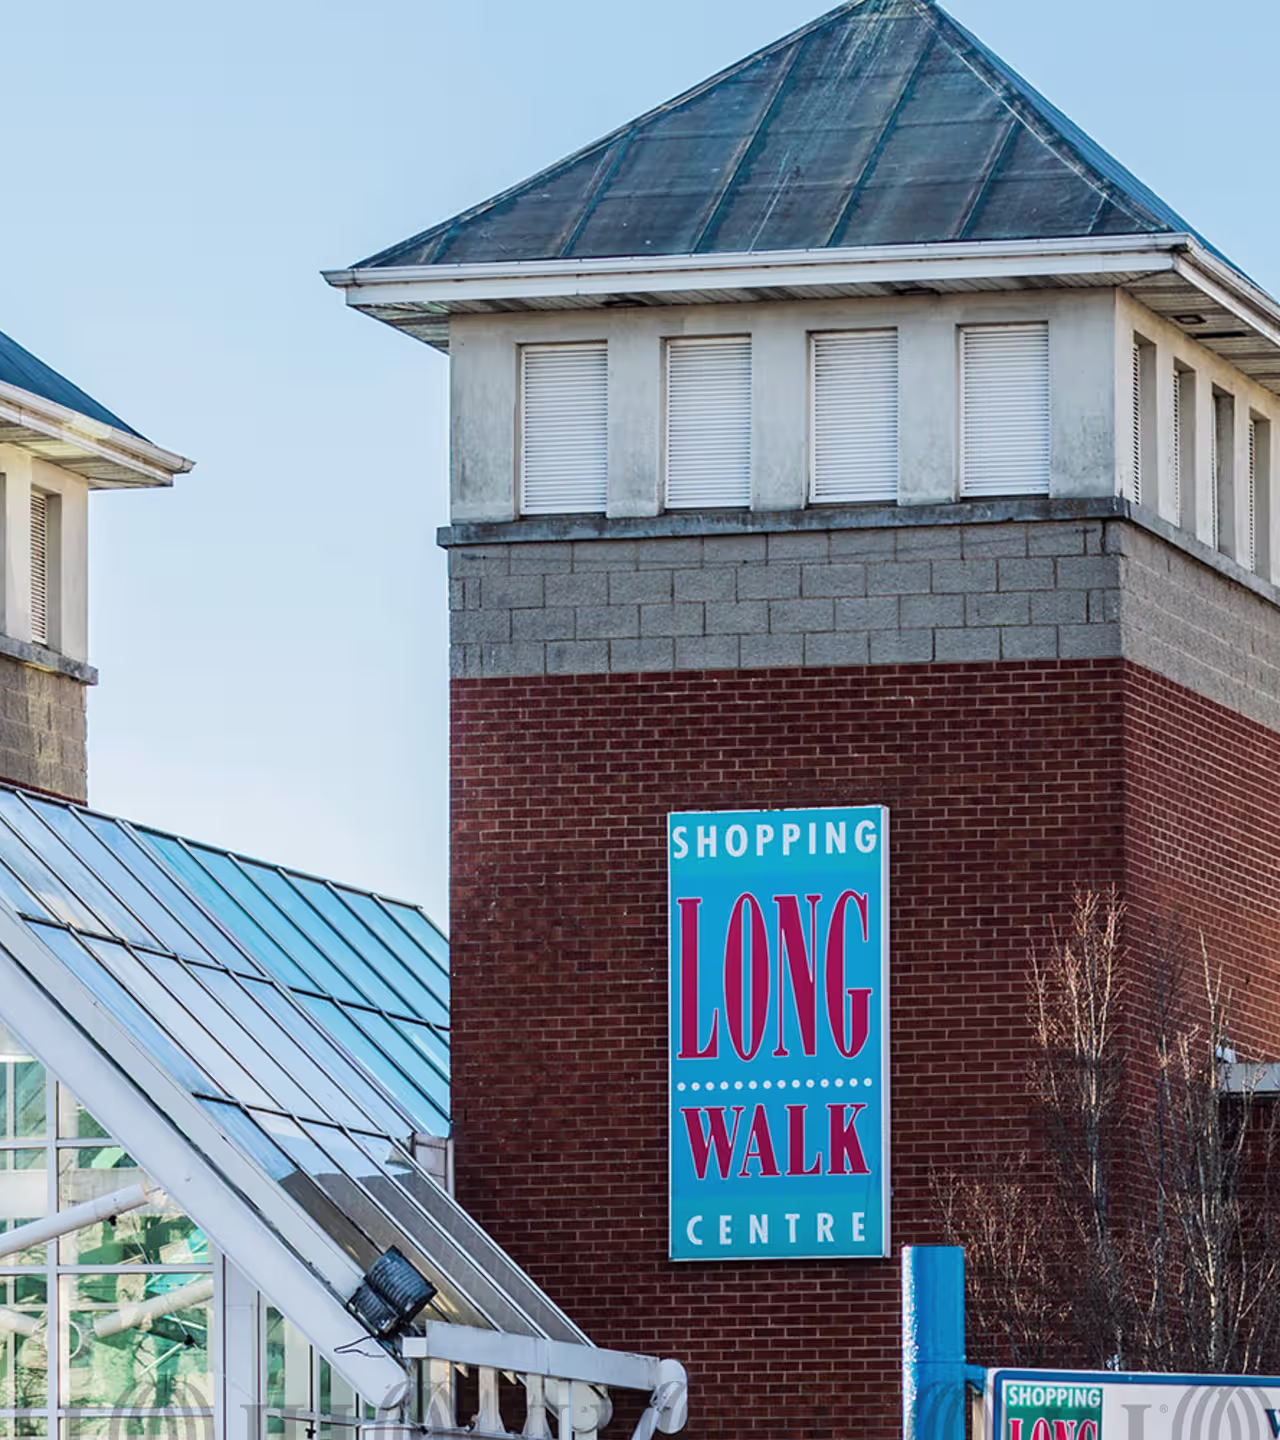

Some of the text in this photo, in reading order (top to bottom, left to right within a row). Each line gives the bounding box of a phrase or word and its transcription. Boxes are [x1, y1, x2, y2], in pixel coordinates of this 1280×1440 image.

[673, 820, 877, 859] SHOPPING
[677, 889, 872, 1062] LONG
[679, 1103, 871, 1180] WALK
[686, 1212, 865, 1246] CENTRE
[1008, 1385, 1101, 1409] SHOPPING
